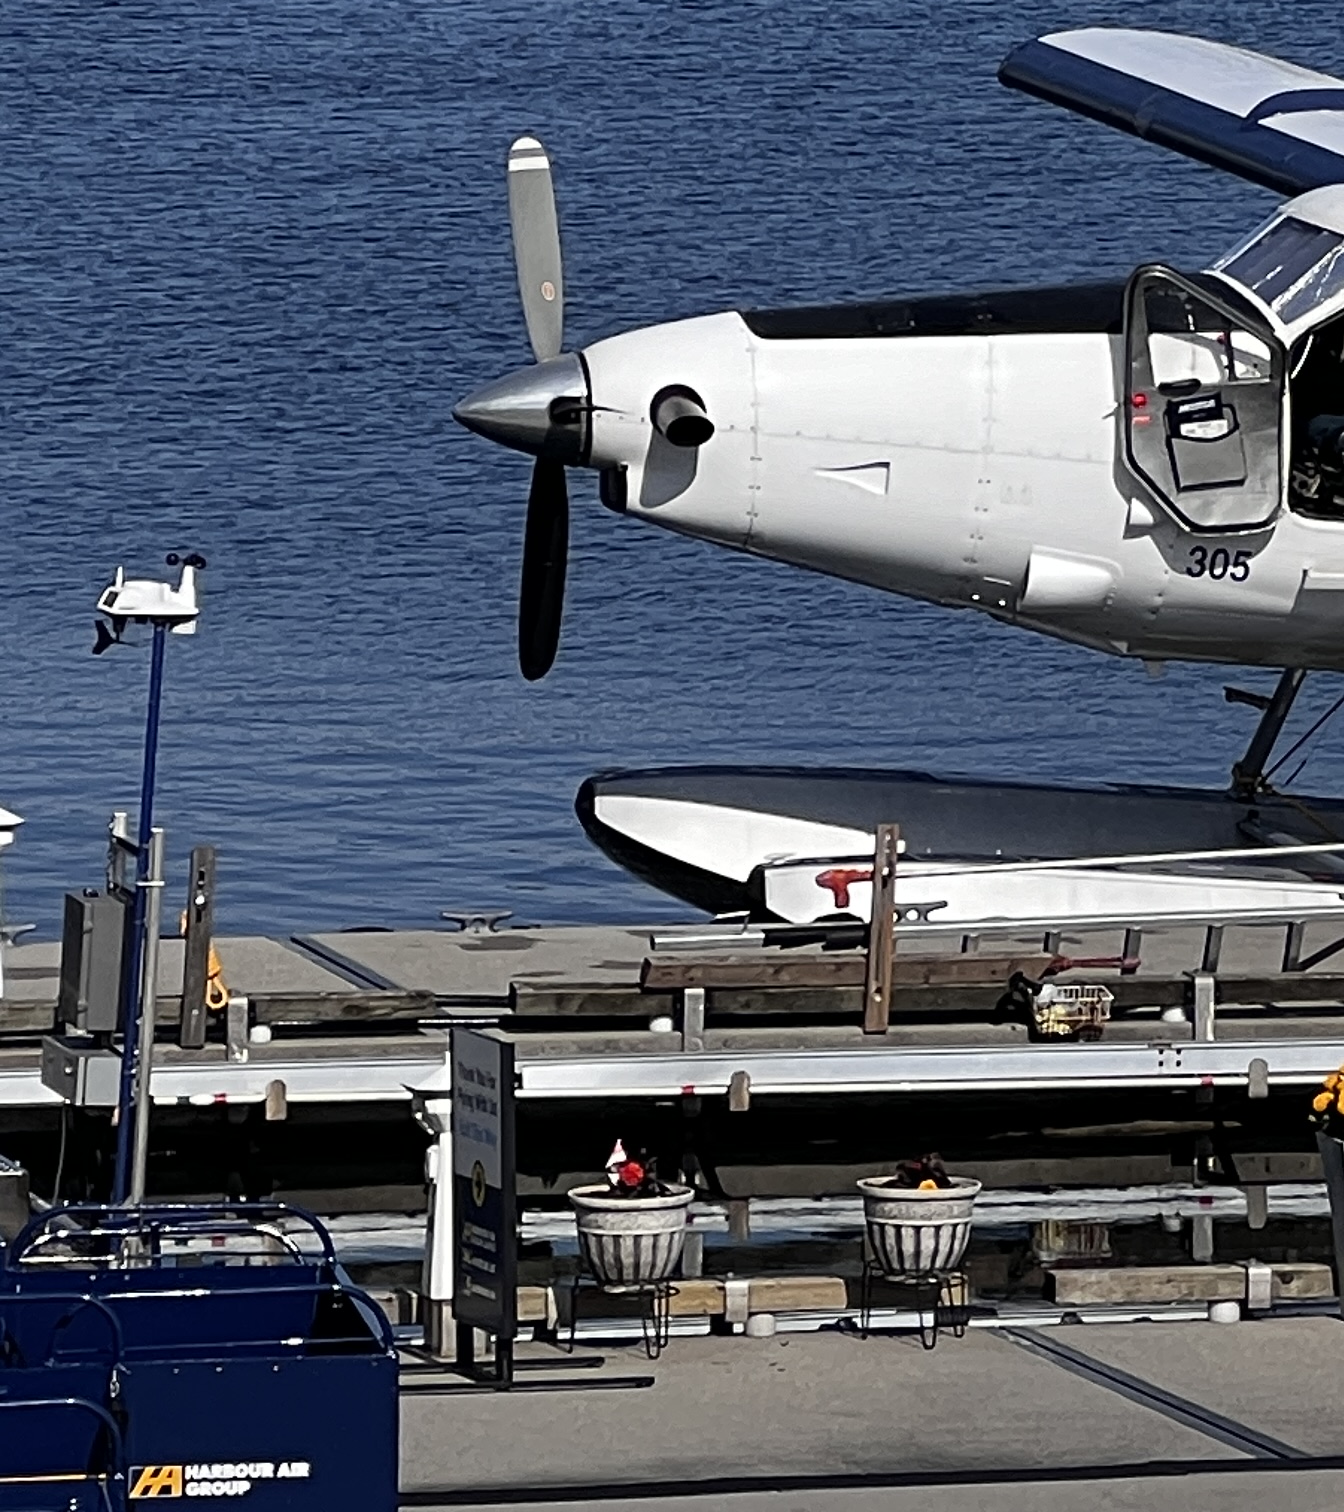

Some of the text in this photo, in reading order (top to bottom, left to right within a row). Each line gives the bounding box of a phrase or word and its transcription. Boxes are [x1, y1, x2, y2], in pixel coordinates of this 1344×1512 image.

[1186, 545, 1253, 582] 305
[184, 1462, 310, 1480] HARBOUR AIR
[184, 1481, 251, 1497] GROUP
